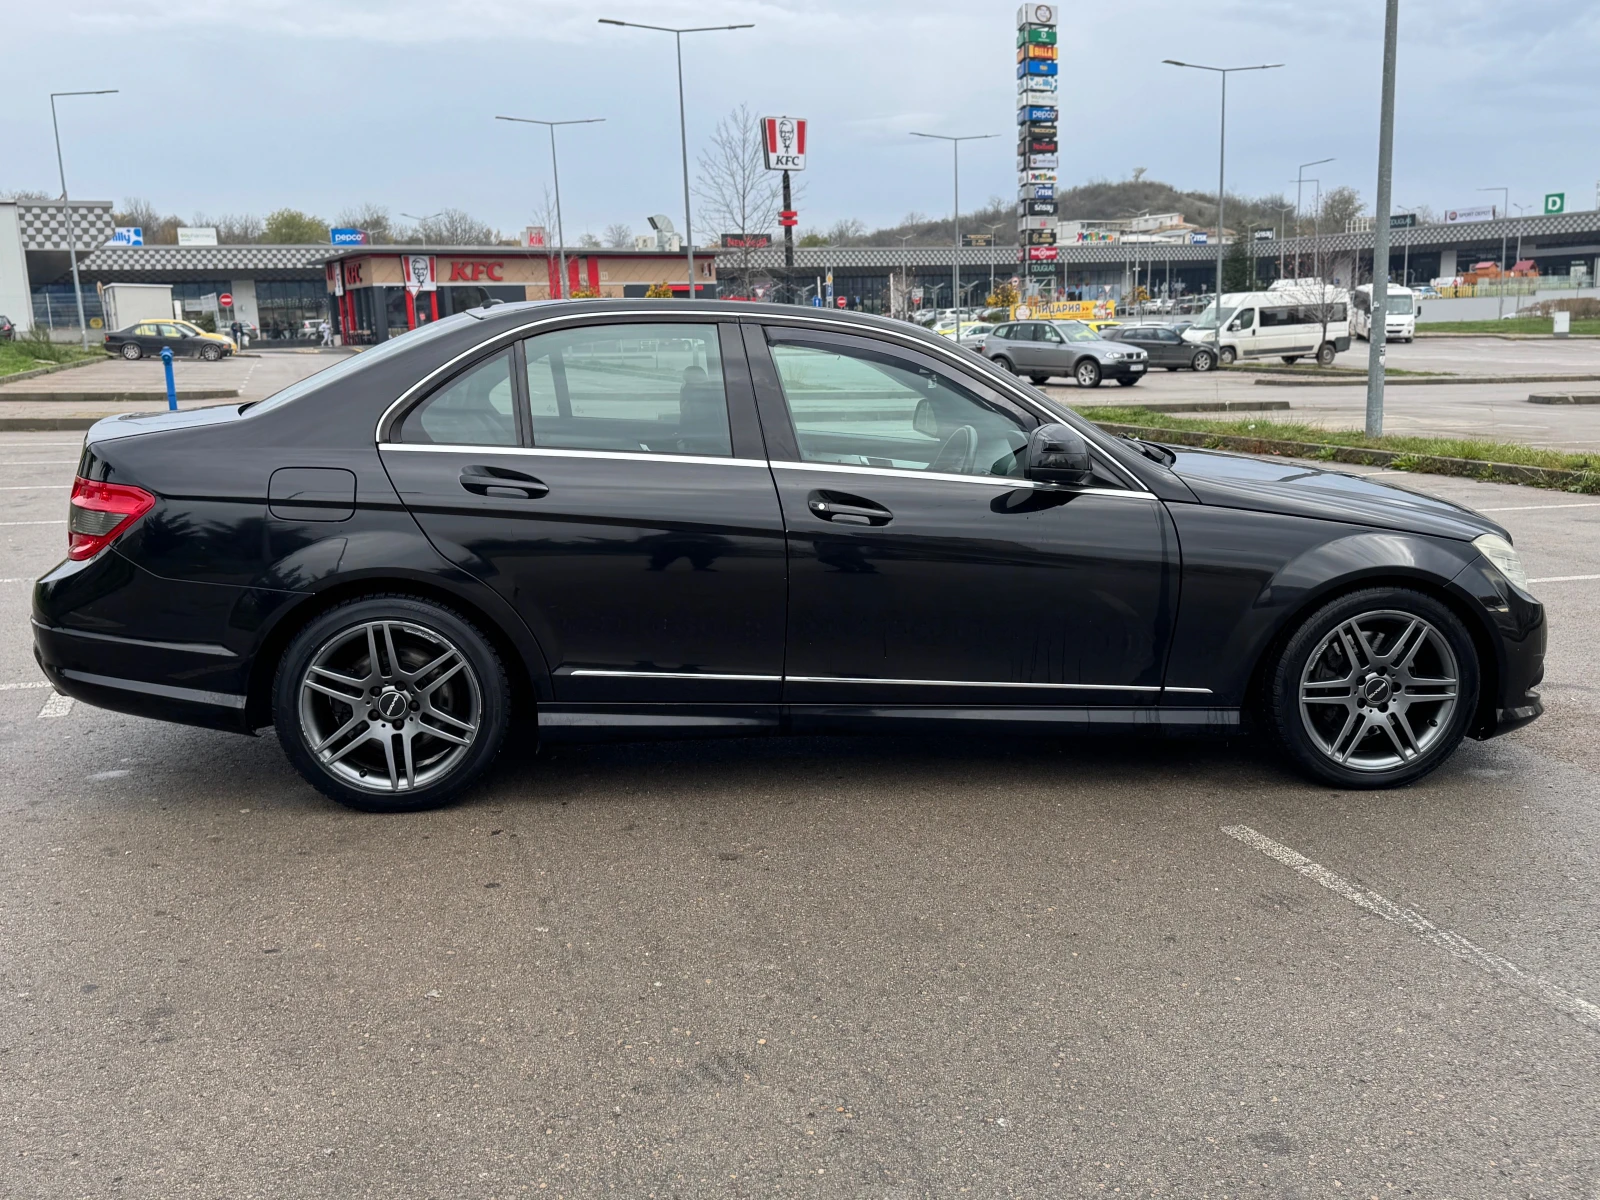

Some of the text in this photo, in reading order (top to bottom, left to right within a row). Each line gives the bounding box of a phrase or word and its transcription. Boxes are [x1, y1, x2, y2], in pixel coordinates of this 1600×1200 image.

[1034, 46, 1053, 58] BILLA
[1032, 110, 1056, 120] pepco
[775, 155, 800, 166] KFC
[1034, 203, 1054, 214] sinsay
[1547, 196, 1561, 211] D
[335, 234, 362, 242] pepco
[529, 231, 544, 246] kik
[1254, 230, 1272, 239] sinsay
[346, 263, 363, 285] KFC
[449, 262, 504, 282] KFC
[1036, 303, 1081, 314] ПИЦАРИЯ
